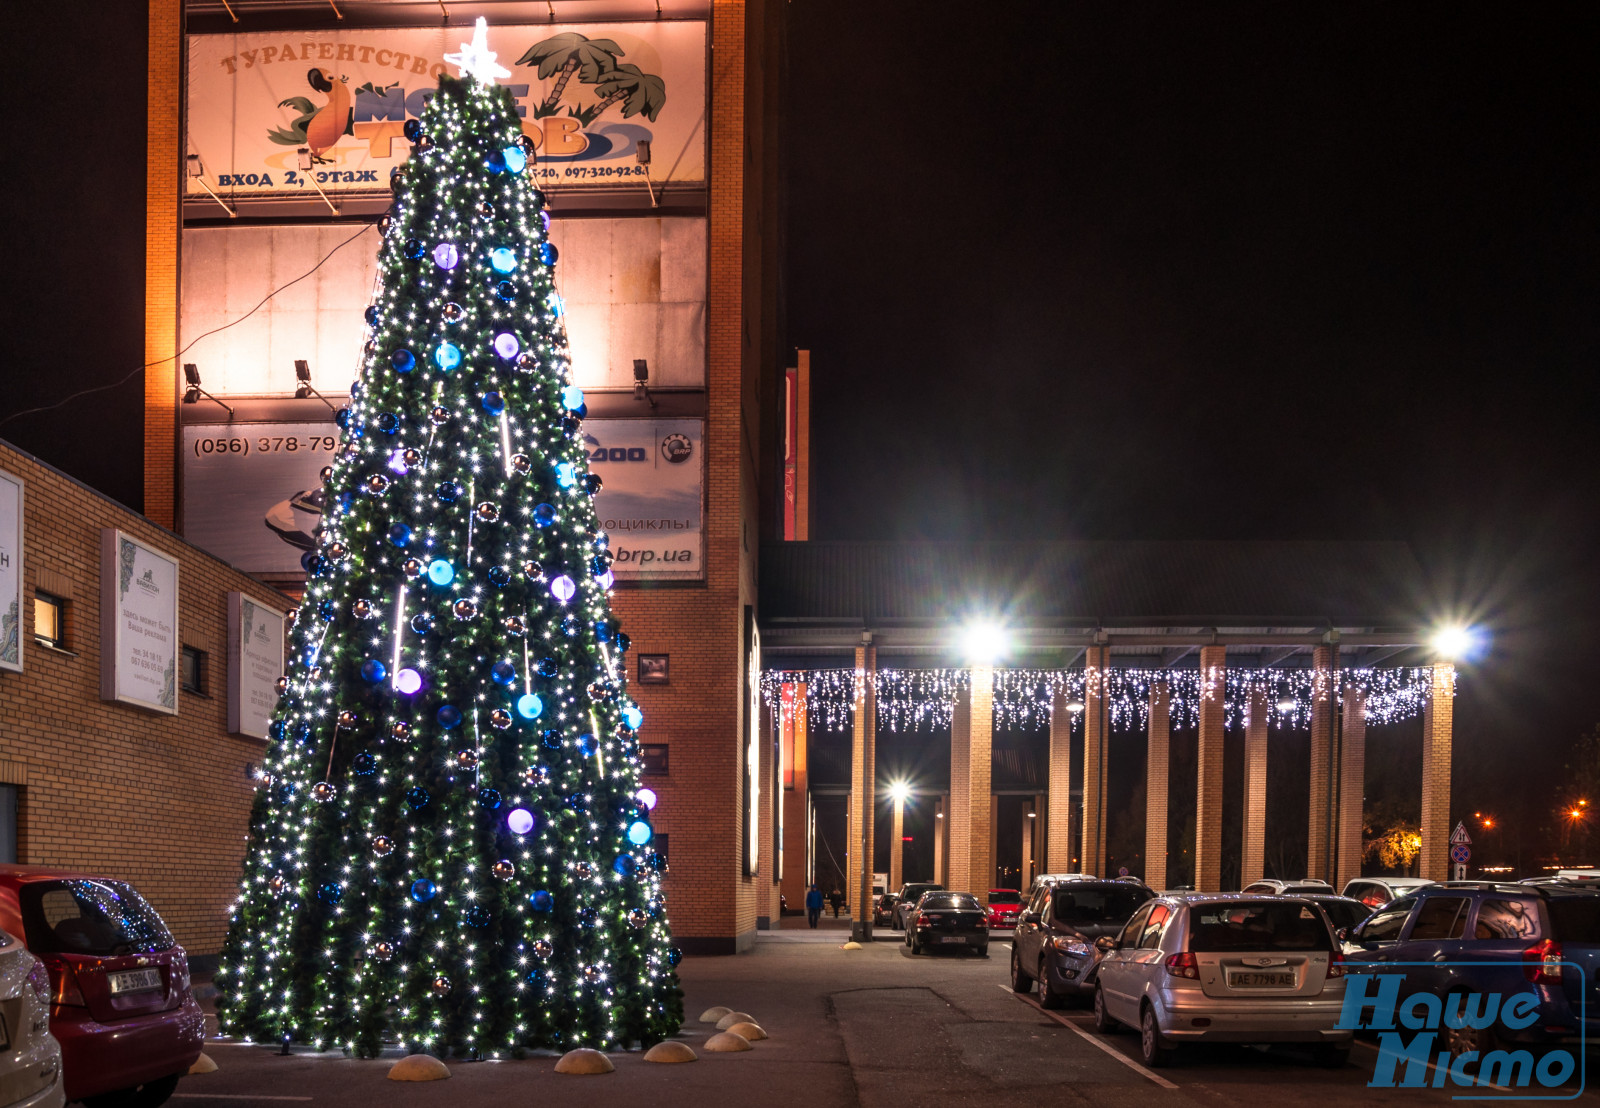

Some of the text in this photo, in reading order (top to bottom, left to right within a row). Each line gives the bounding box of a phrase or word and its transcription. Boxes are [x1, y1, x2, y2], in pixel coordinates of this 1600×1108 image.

[221, 42, 449, 81] ТУРАГЕНТСТВО
[218, 172, 273, 187] вход
[284, 171, 305, 187] 2,
[317, 169, 379, 184] этаж
[194, 438, 249, 457] (056)
[616, 546, 692, 566] brp.ua
[1237, 973, 1292, 985] AE 7798 AE
